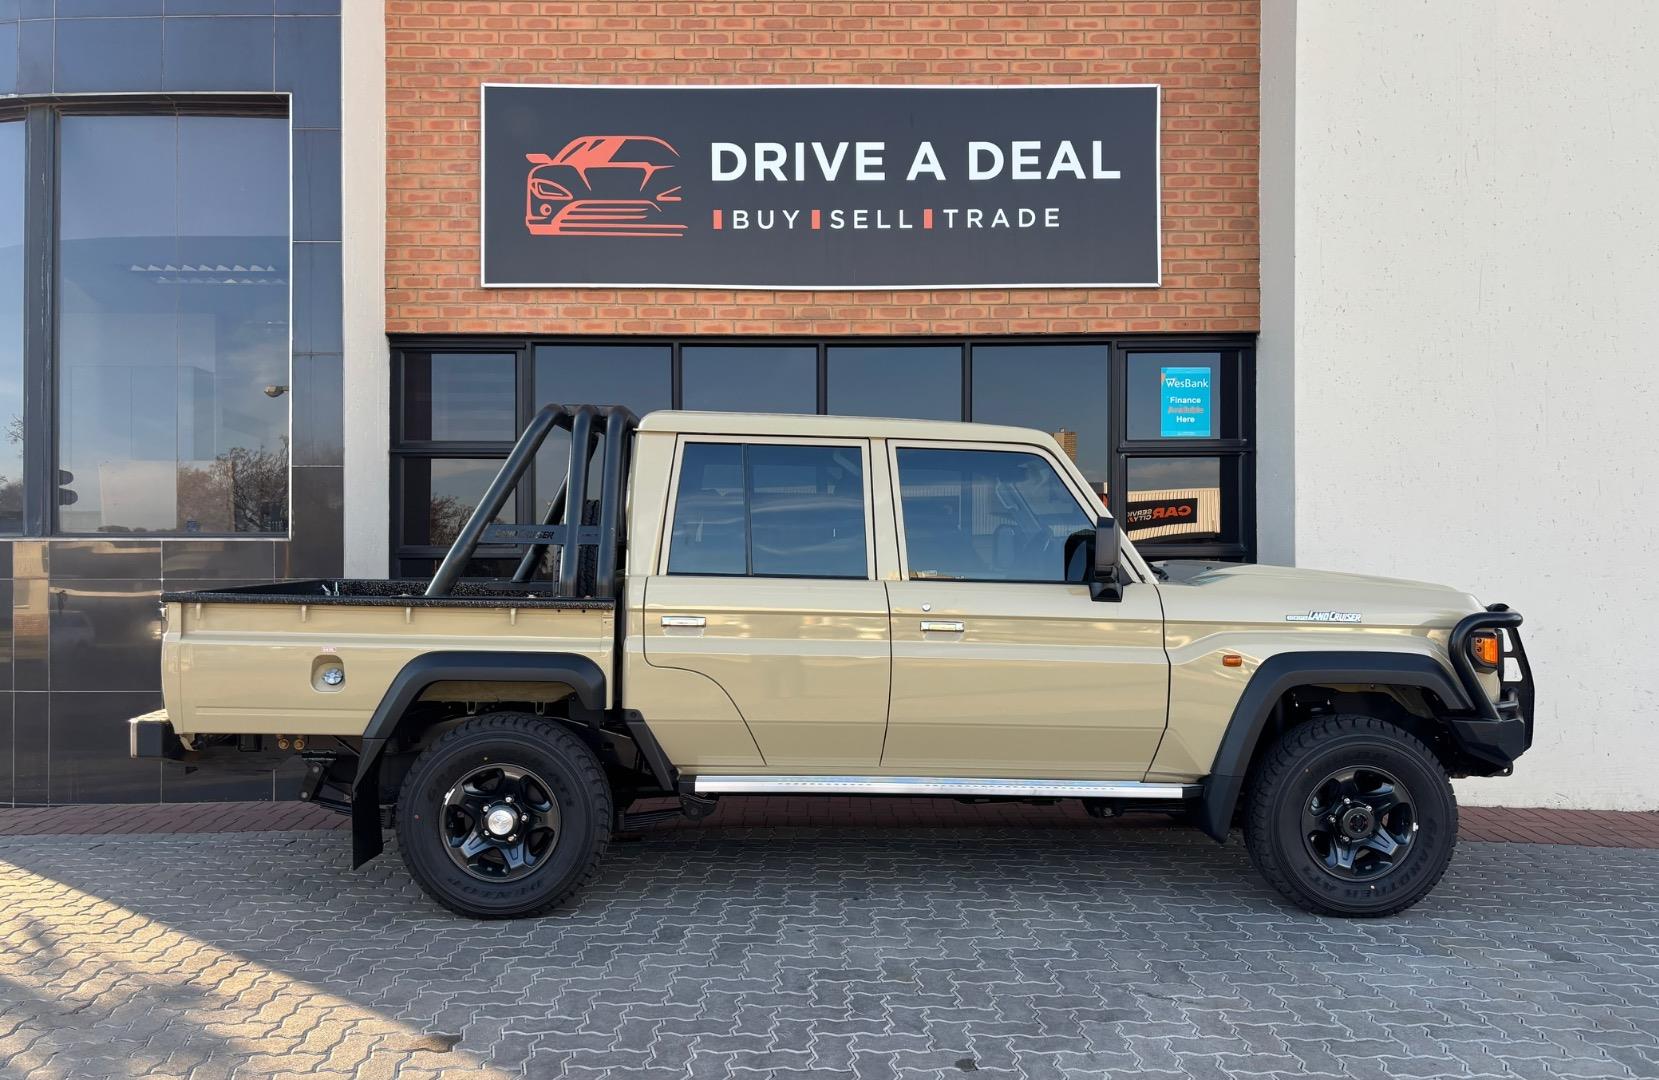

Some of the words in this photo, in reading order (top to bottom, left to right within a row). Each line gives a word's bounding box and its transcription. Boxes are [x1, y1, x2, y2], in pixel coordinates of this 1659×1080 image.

[711, 141, 886, 182] DRIVE
[905, 141, 947, 182] A
[968, 140, 1121, 181] DEAL
[732, 209, 800, 231] BUY
[830, 208, 913, 230] SELL
[943, 207, 1061, 229] TRADE
[1165, 378, 1209, 388] WesBank
[1169, 396, 1202, 404] Finance
[1176, 415, 1195, 423] Here
